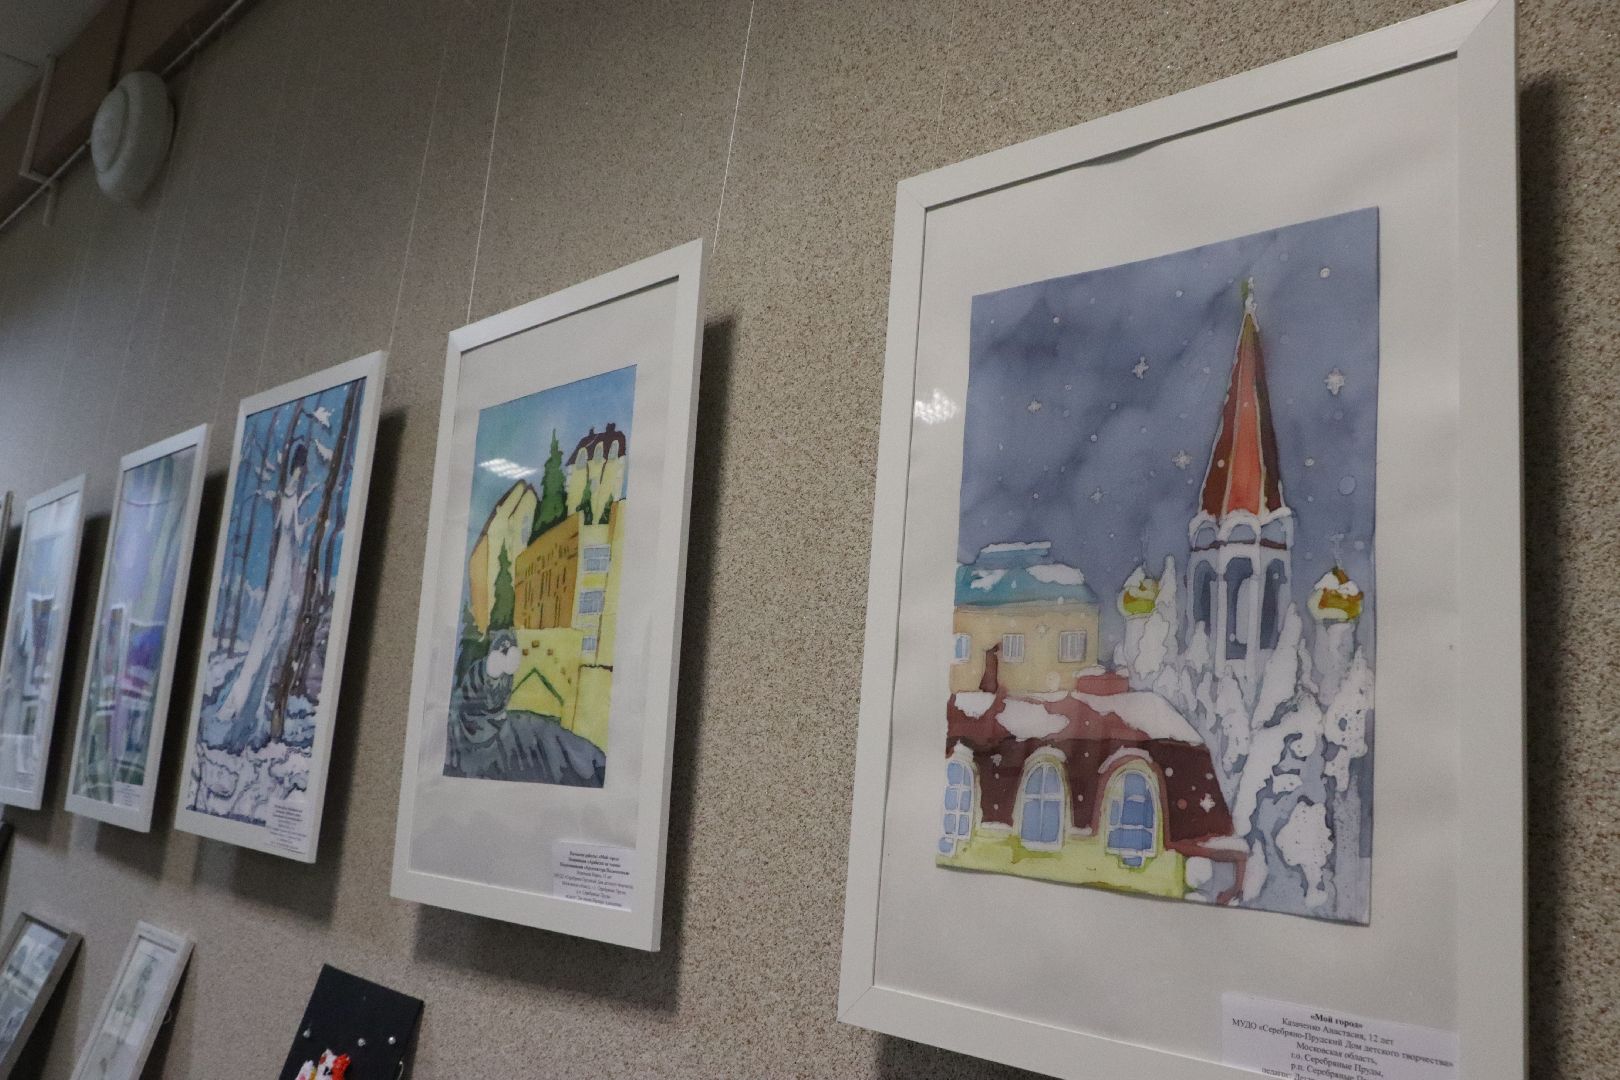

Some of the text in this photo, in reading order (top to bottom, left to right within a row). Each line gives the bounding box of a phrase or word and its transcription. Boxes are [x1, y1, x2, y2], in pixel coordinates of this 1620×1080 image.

[1310, 1013, 1333, 1024] «Мой
[1232, 1018, 1257, 1030] МУДО
[1345, 1041, 1362, 1050] Дом
[1363, 1046, 1399, 1058] детского
[1370, 1034, 1378, 1043] 12
[1380, 1038, 1394, 1046] лет
[1296, 1041, 1343, 1058] Московская
[1305, 1054, 1353, 1070] Серебряные
